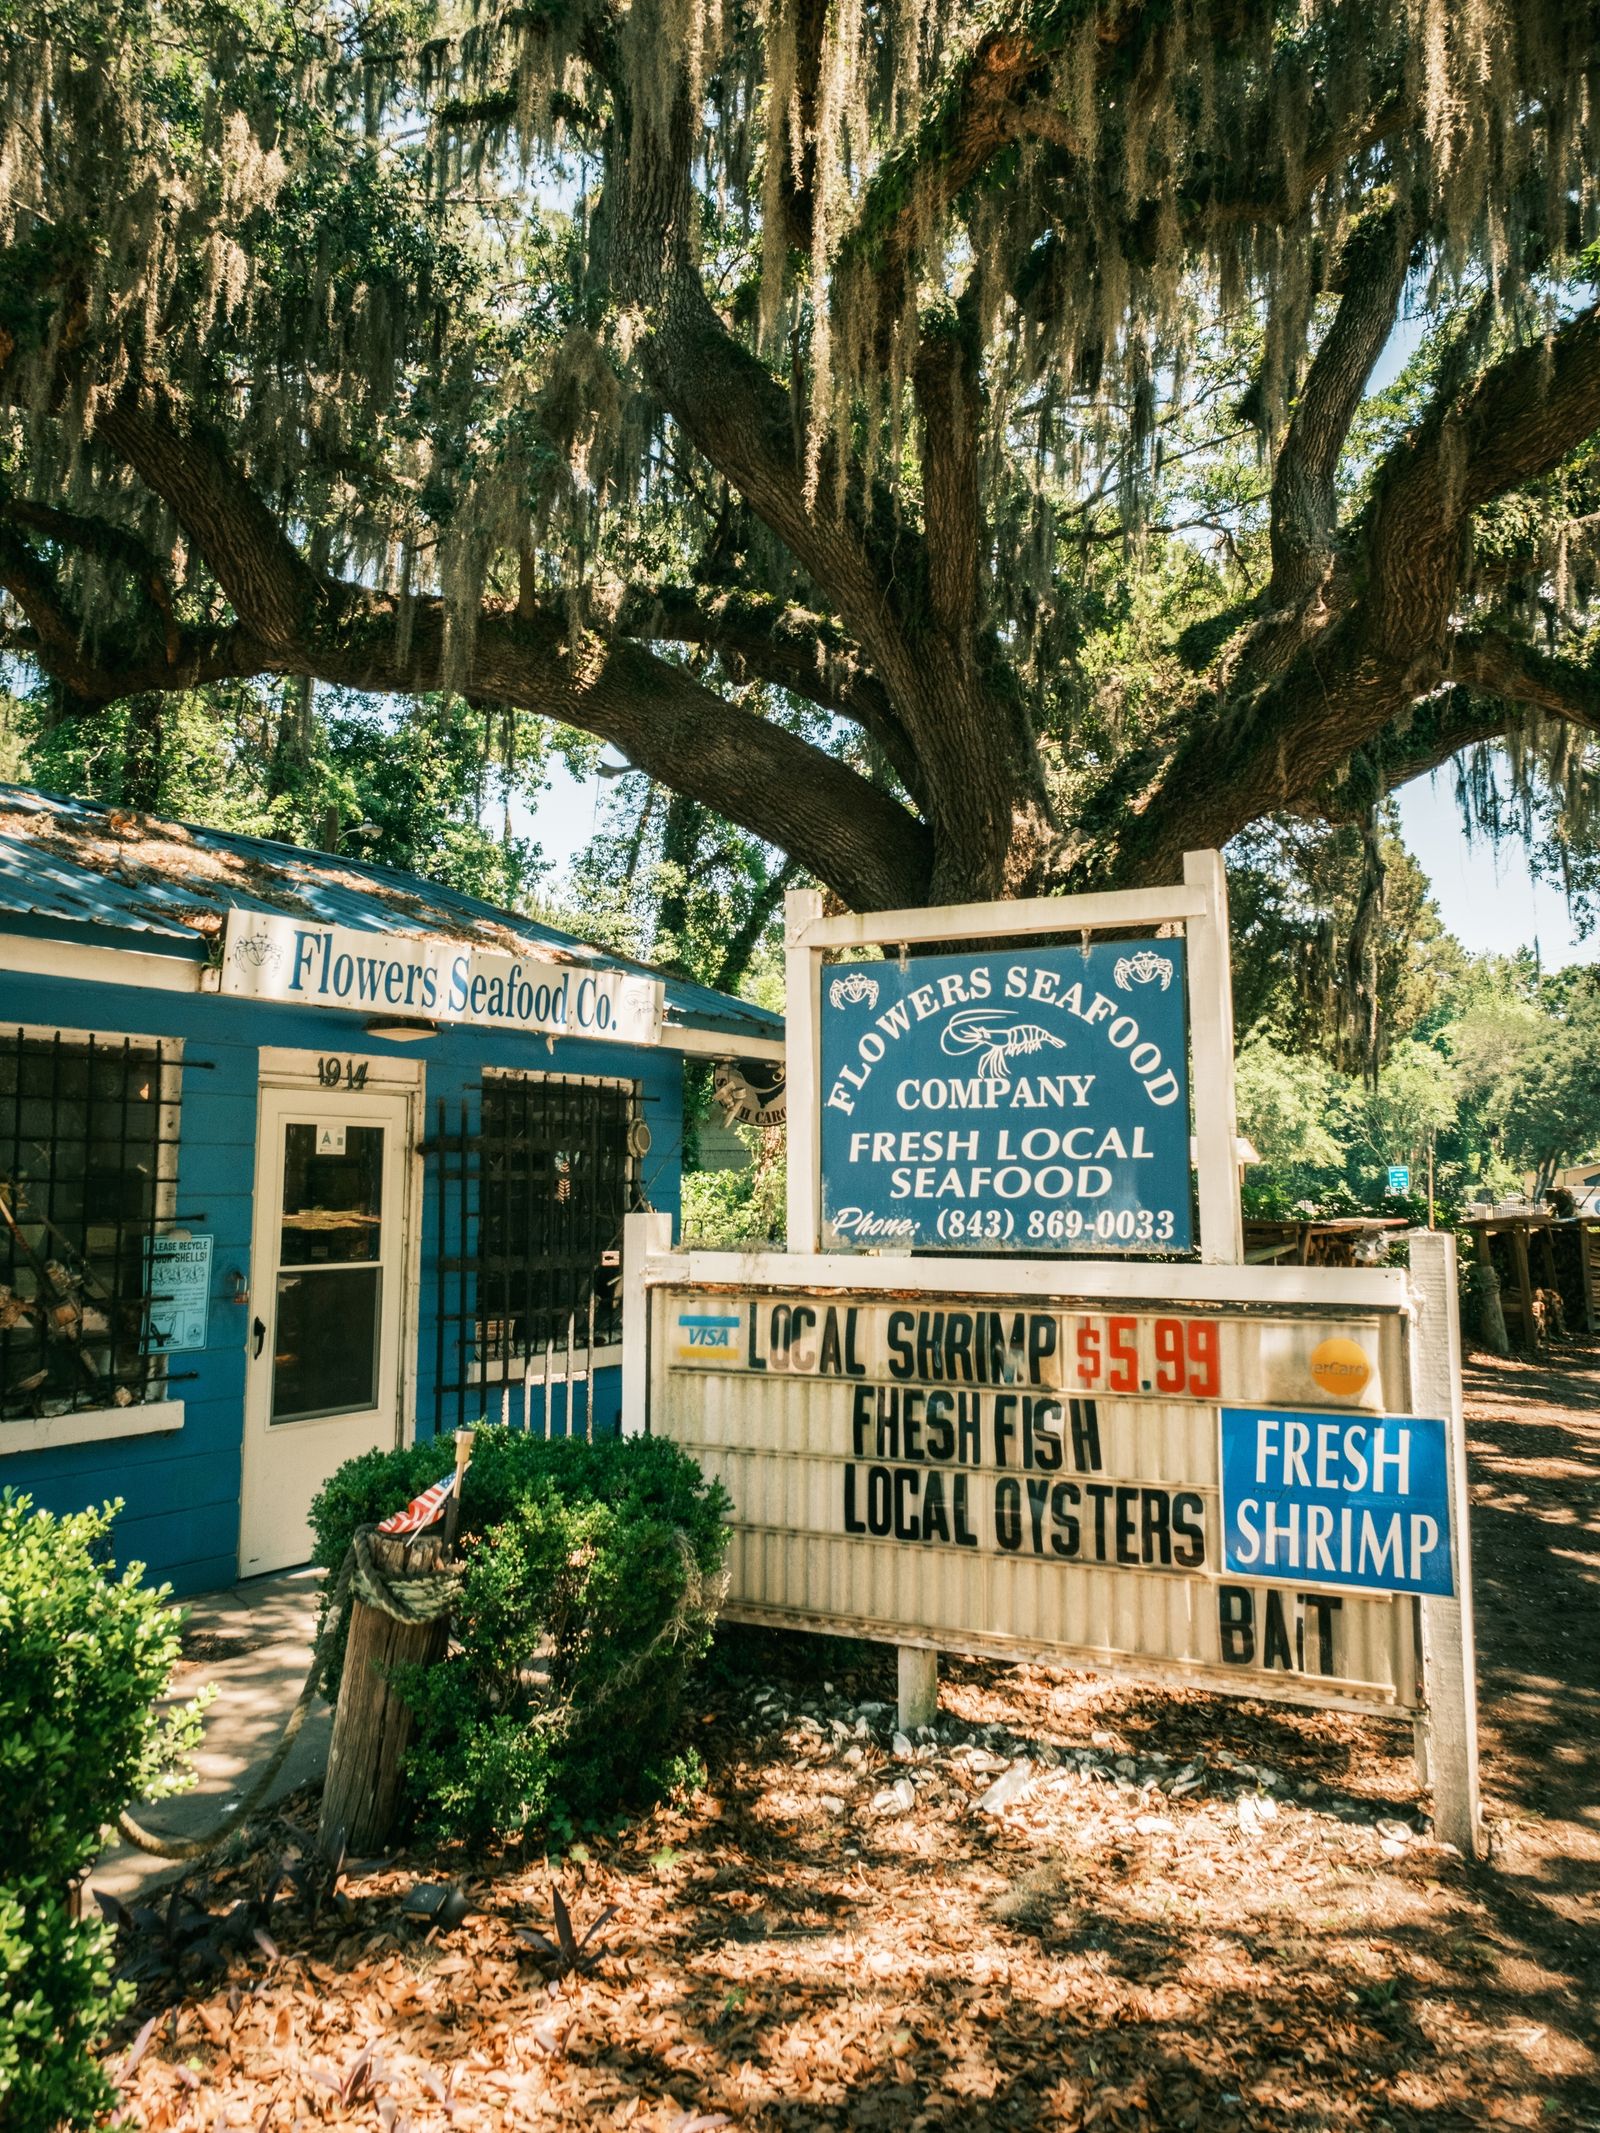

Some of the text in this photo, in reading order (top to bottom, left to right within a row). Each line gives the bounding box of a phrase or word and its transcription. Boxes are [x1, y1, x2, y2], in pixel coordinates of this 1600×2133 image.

[289, 930, 617, 1031] Flowers Seafood Co.
[827, 966, 1180, 1116] FLOWERS SEAFOOD
[317, 1057, 369, 1090] 1914
[896, 1075, 1096, 1110] COMPANY
[755, 1106, 786, 1124] CARO
[849, 1126, 1154, 1163] FRESH LOCAL
[889, 1165, 1113, 1199] SEAFOOD
[831, 1207, 1175, 1240] Phone: (843) 869-0033
[151, 1240, 208, 1252] LEASE RECYCLE
[174, 1252, 208, 1263] SHELLS!
[689, 1327, 729, 1346] VISA
[748, 1301, 1221, 1397] LOCAL SHRIMP $5.99
[993, 1394, 1102, 1471] FISH
[1255, 1419, 1411, 1495] FRESH
[844, 1463, 1206, 1568] LOCAL OYSTERS
[1236, 1498, 1439, 1580] SHRIMP
